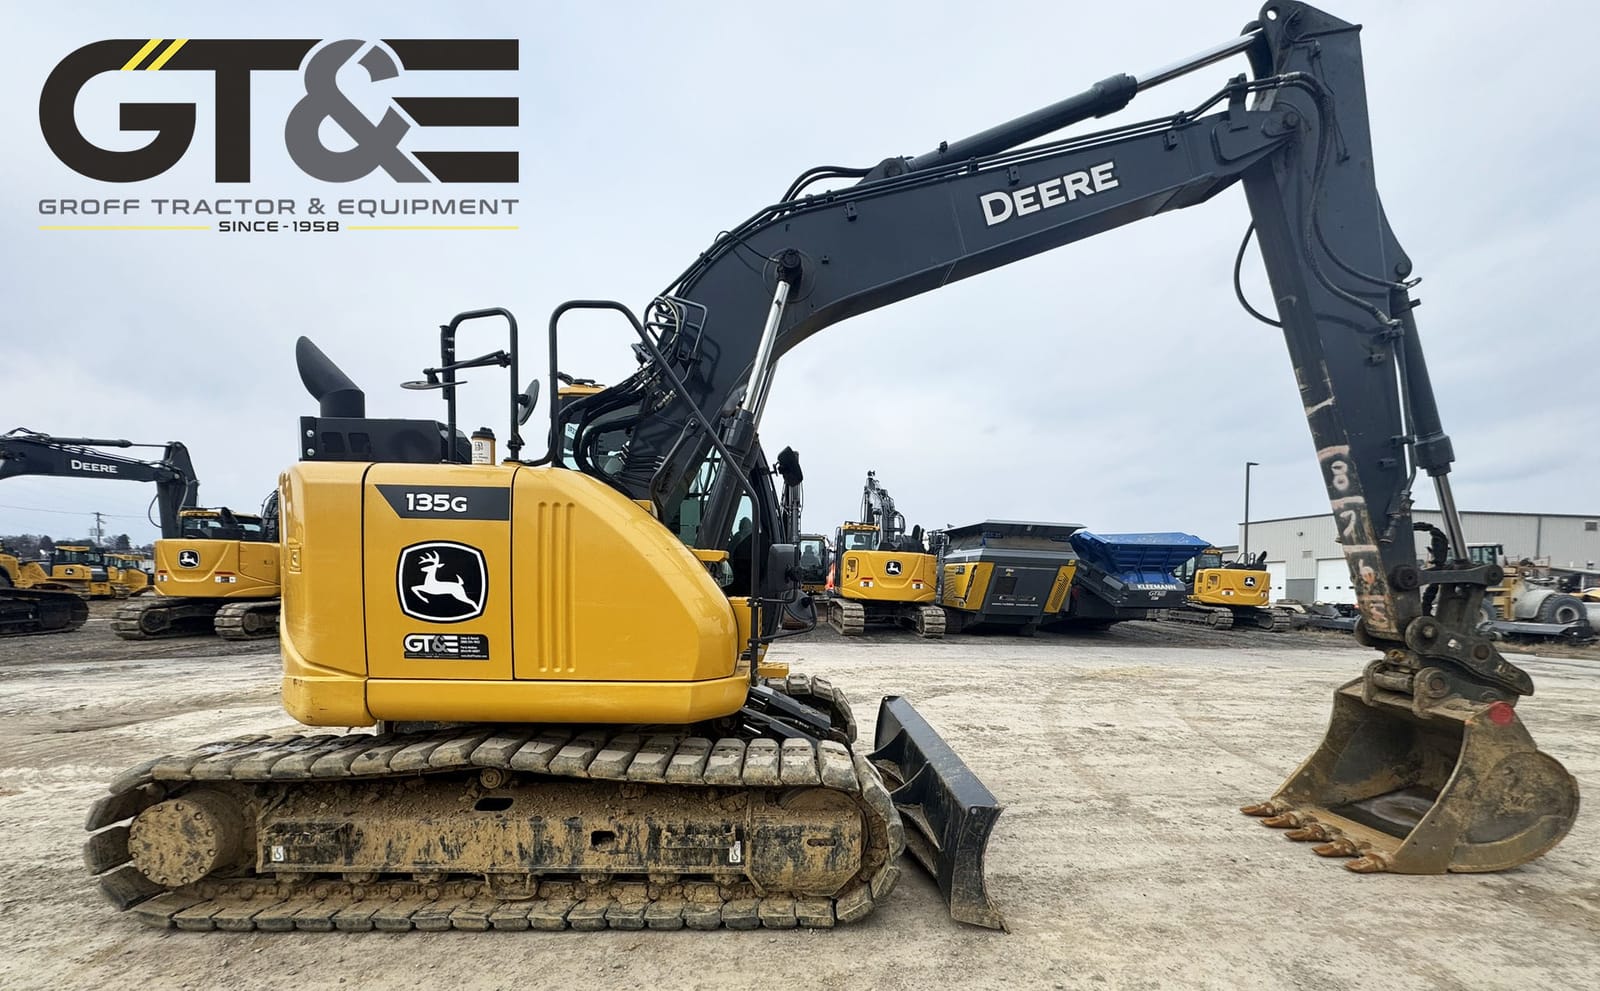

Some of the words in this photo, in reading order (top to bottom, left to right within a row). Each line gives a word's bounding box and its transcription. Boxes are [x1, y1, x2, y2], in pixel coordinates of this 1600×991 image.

[980, 161, 1119, 226] DEERE
[71, 459, 118, 474] DEERE
[406, 493, 467, 513] 135G
[404, 634, 459, 653] GT&E
